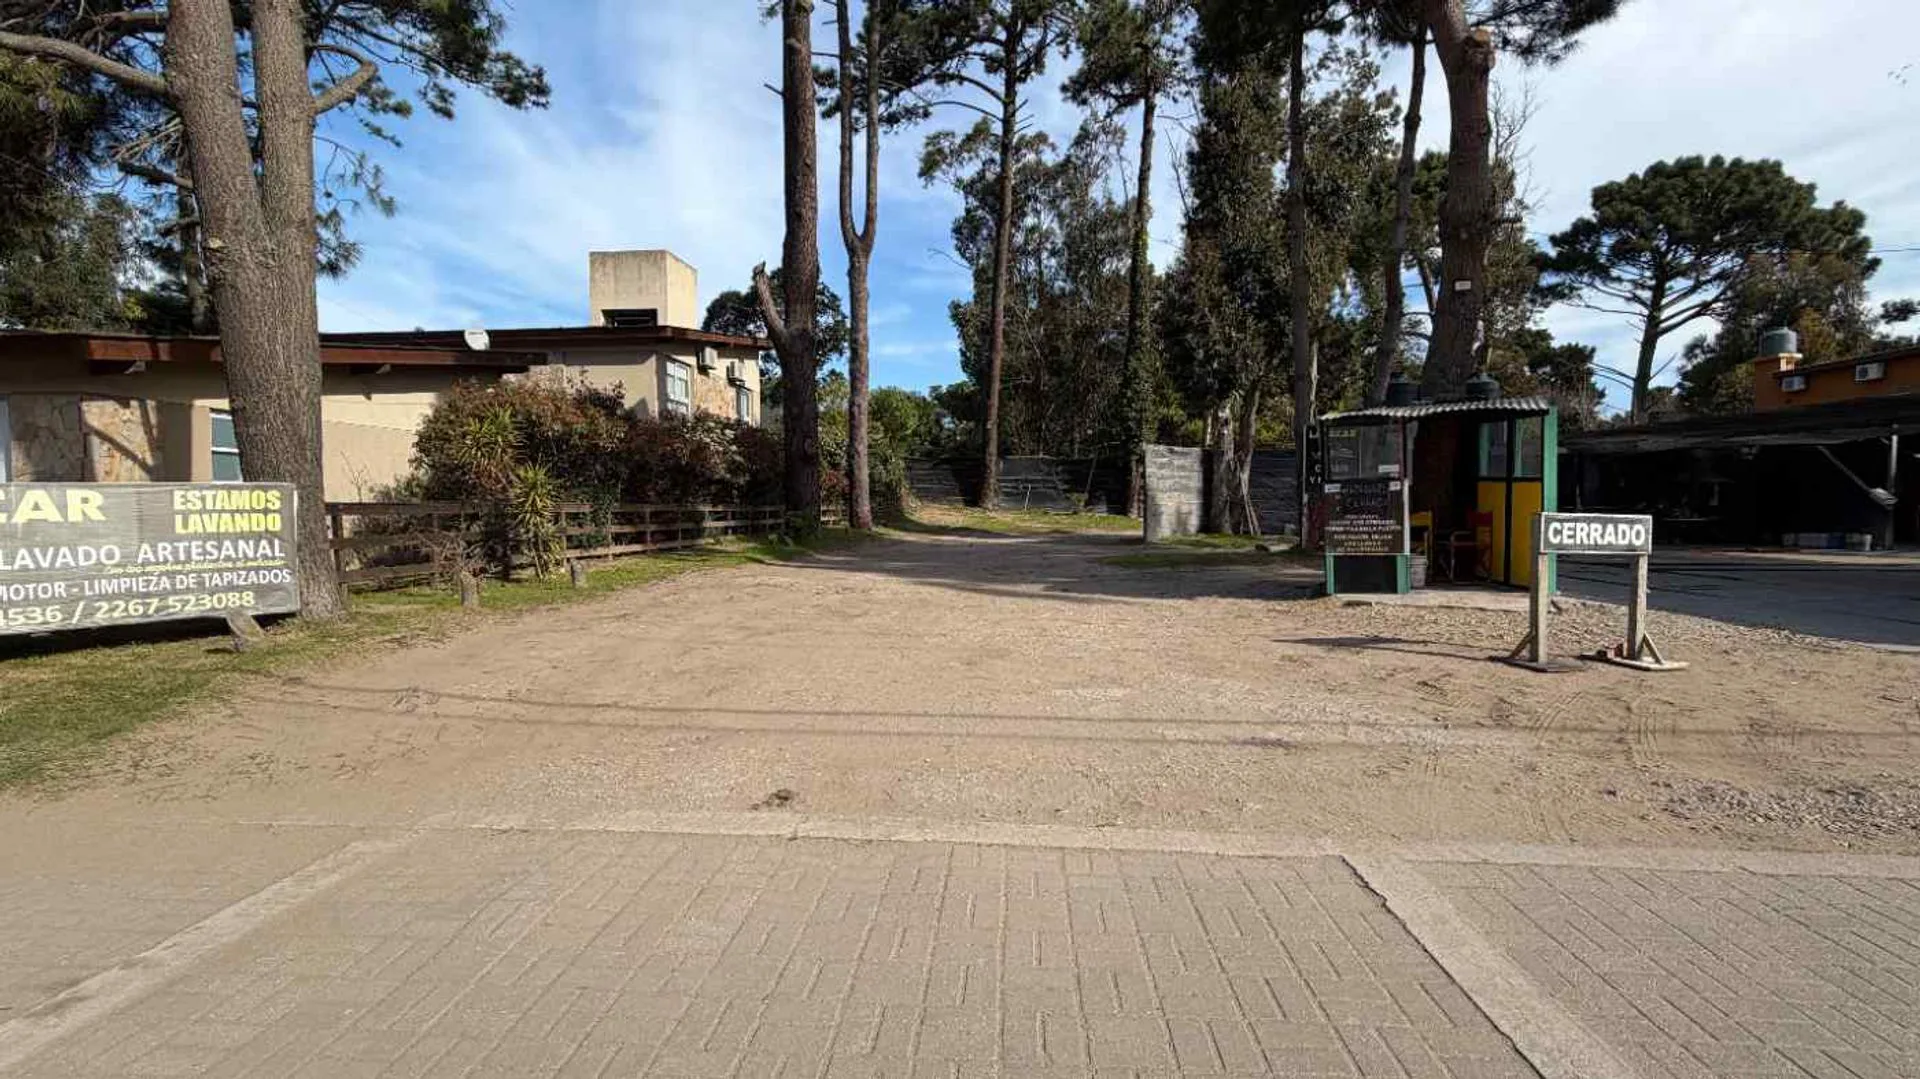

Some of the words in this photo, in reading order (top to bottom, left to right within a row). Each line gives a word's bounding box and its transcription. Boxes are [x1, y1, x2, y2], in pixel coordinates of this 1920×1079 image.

[0, 489, 106, 523] AR
[173, 490, 281, 510] ESTAMOS
[175, 513, 281, 534] LAVANDO
[1548, 522, 1645, 546] CERRADO
[0, 545, 121, 570] LAVADO
[137, 539, 285, 564] ARTESANAL
[84, 575, 171, 596] LIMPIEZA
[176, 574, 197, 590] DE
[200, 569, 292, 588] TAPIZADOS
